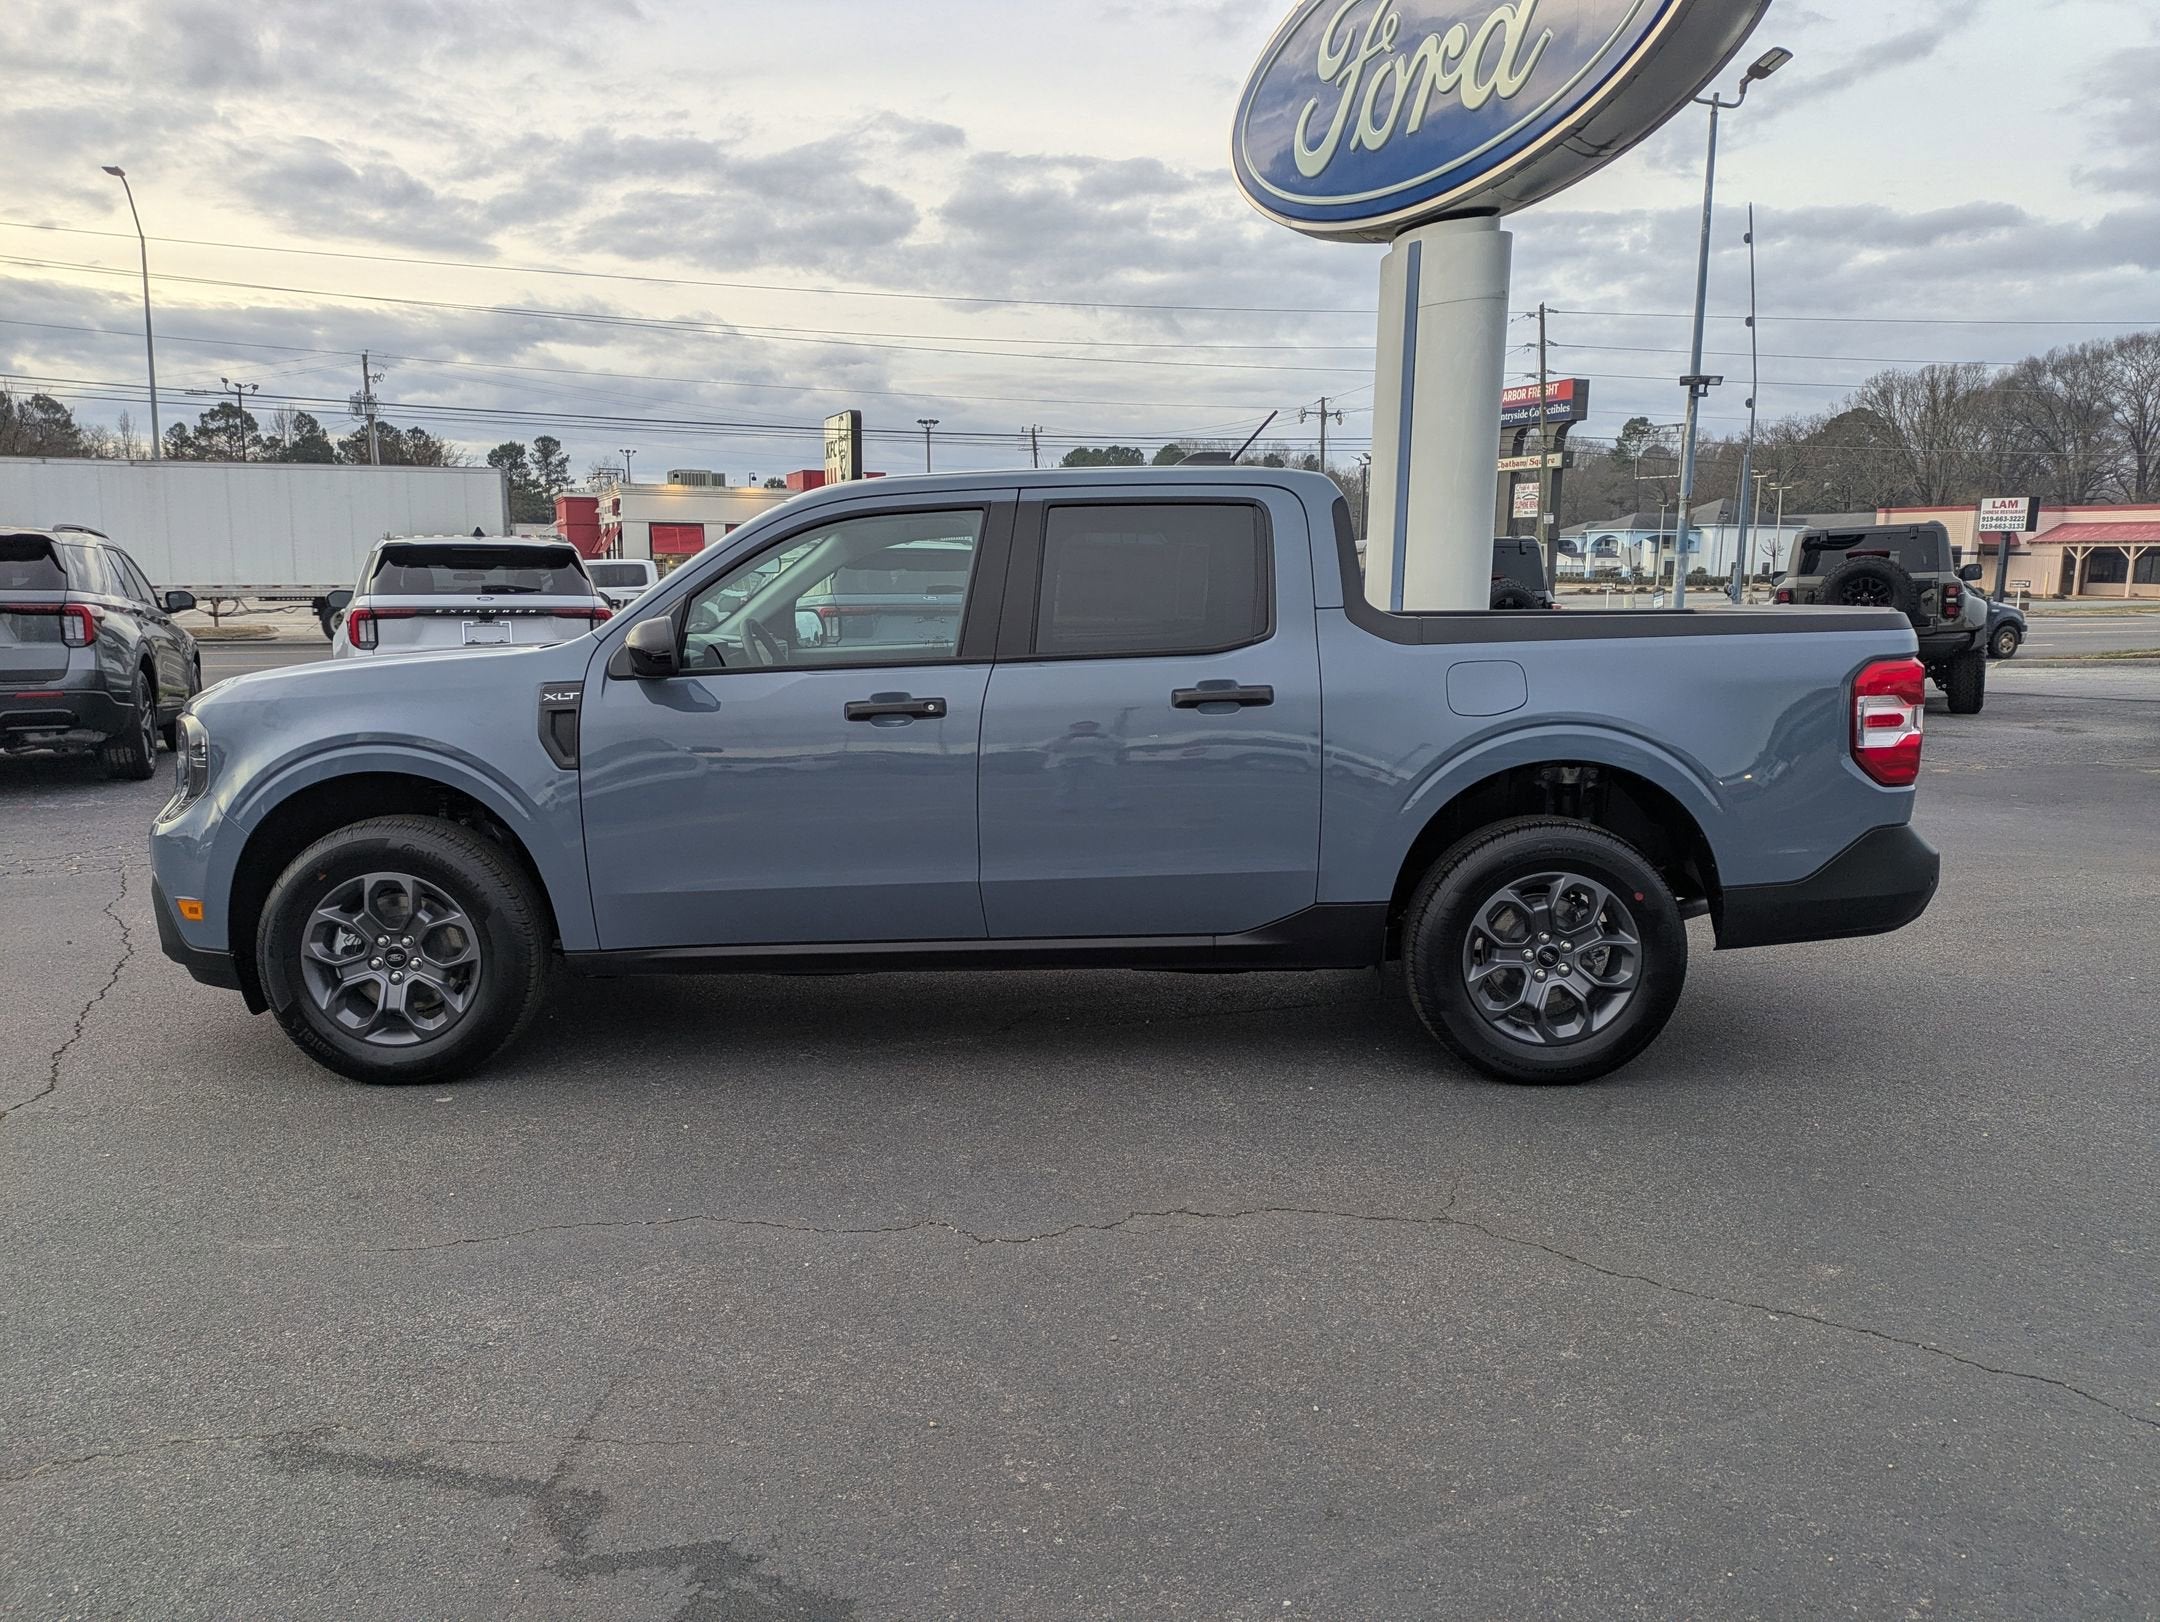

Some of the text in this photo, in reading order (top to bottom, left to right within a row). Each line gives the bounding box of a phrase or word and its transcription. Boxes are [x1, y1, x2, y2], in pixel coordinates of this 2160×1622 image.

[1294, 0, 1553, 178] Ford
[1502, 383, 1560, 402] ARBOR FREGHT
[1500, 403, 1570, 422] ntryside Colctibles
[1529, 458, 1555, 466] Sqre
[1992, 500, 2018, 509] LAM
[543, 692, 580, 701] XLT
